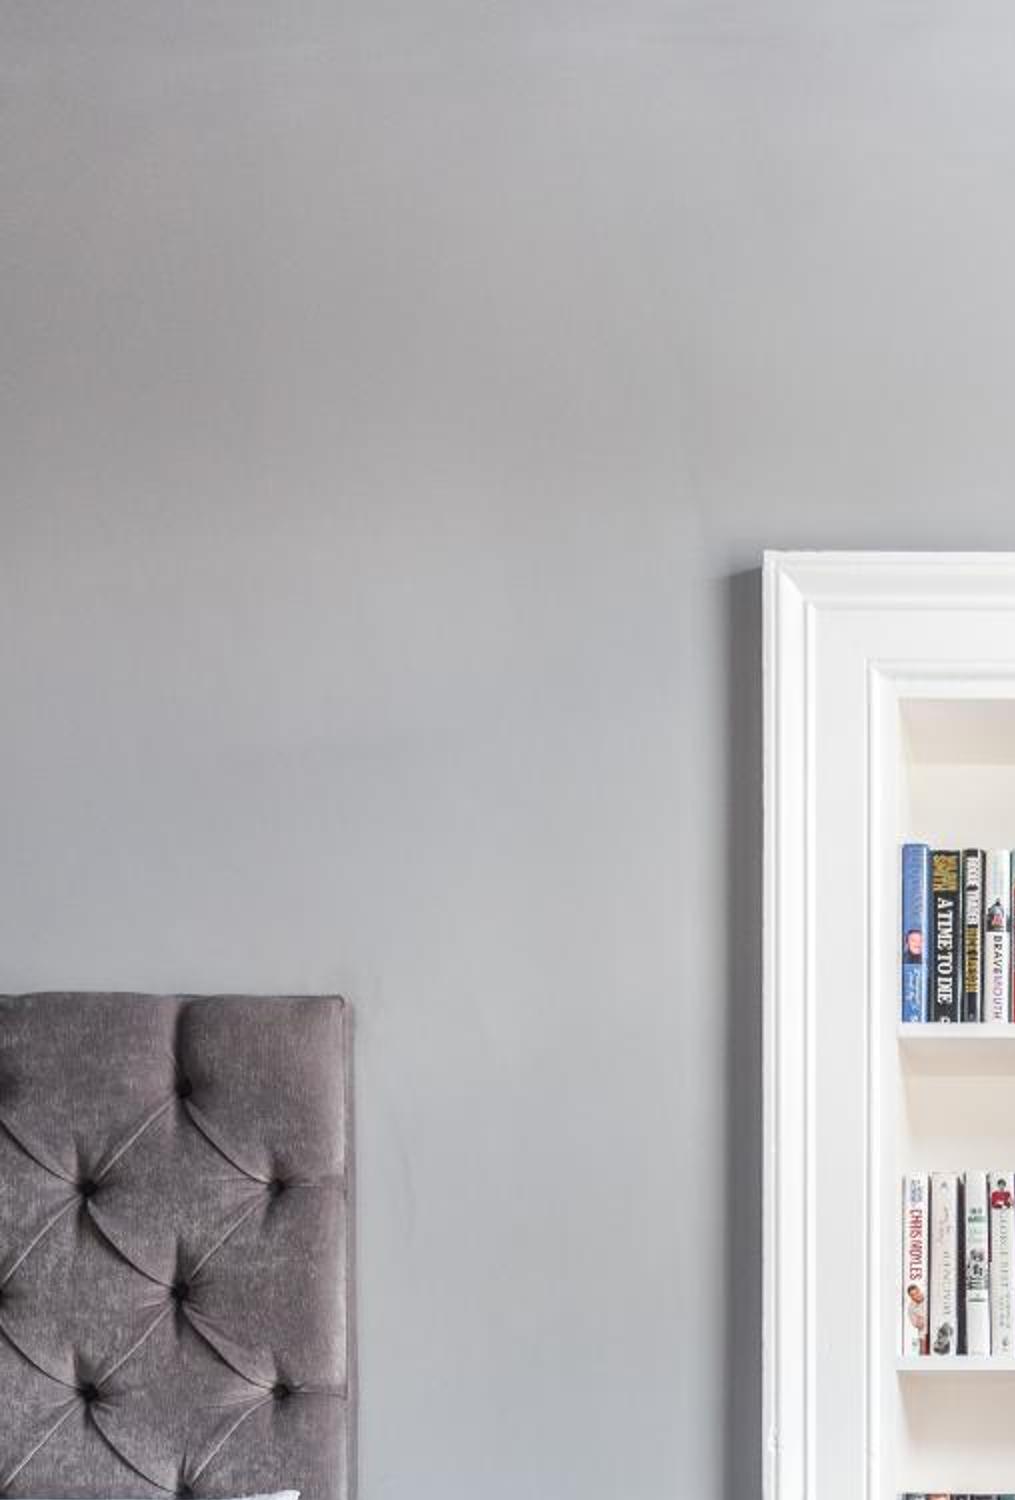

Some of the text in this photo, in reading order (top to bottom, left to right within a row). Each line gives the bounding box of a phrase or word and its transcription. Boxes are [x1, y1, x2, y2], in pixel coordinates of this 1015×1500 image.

[938, 897, 954, 909] A
[938, 911, 953, 950] TIME
[938, 952, 953, 974] TO
[993, 935, 1003, 1019] BRAVEMOUTH
[938, 977, 953, 1004] DIE
[909, 1209, 923, 1281] CHRIS MOYLES
